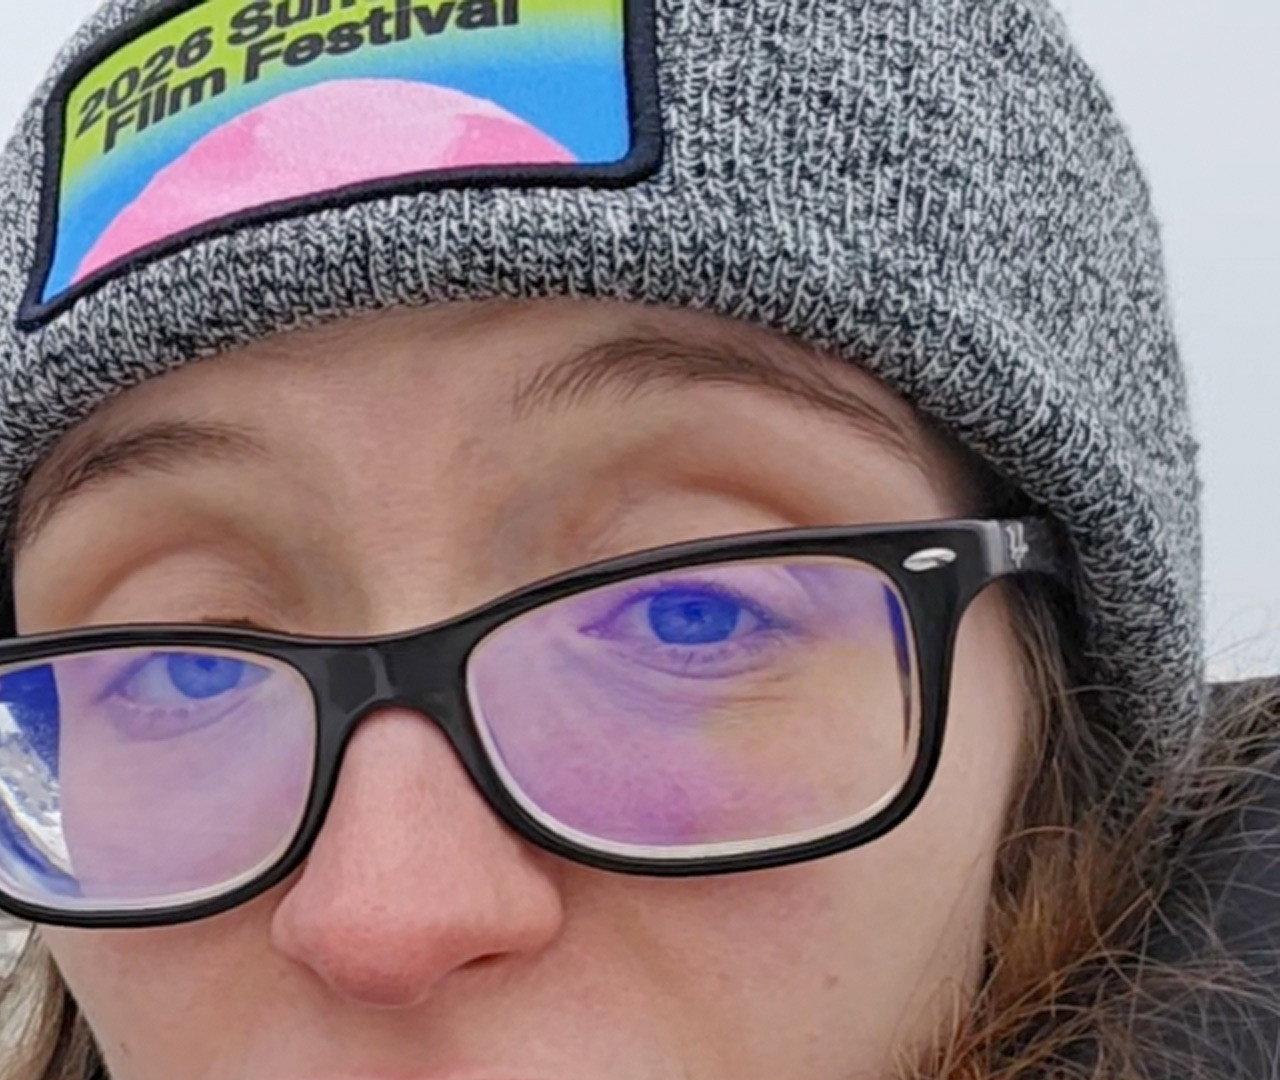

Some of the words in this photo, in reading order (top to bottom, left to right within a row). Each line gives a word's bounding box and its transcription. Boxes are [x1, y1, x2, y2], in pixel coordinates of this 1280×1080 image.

[75, 26, 213, 139] 2026
[103, 67, 226, 154] Film
[243, 0, 520, 84] Festival
